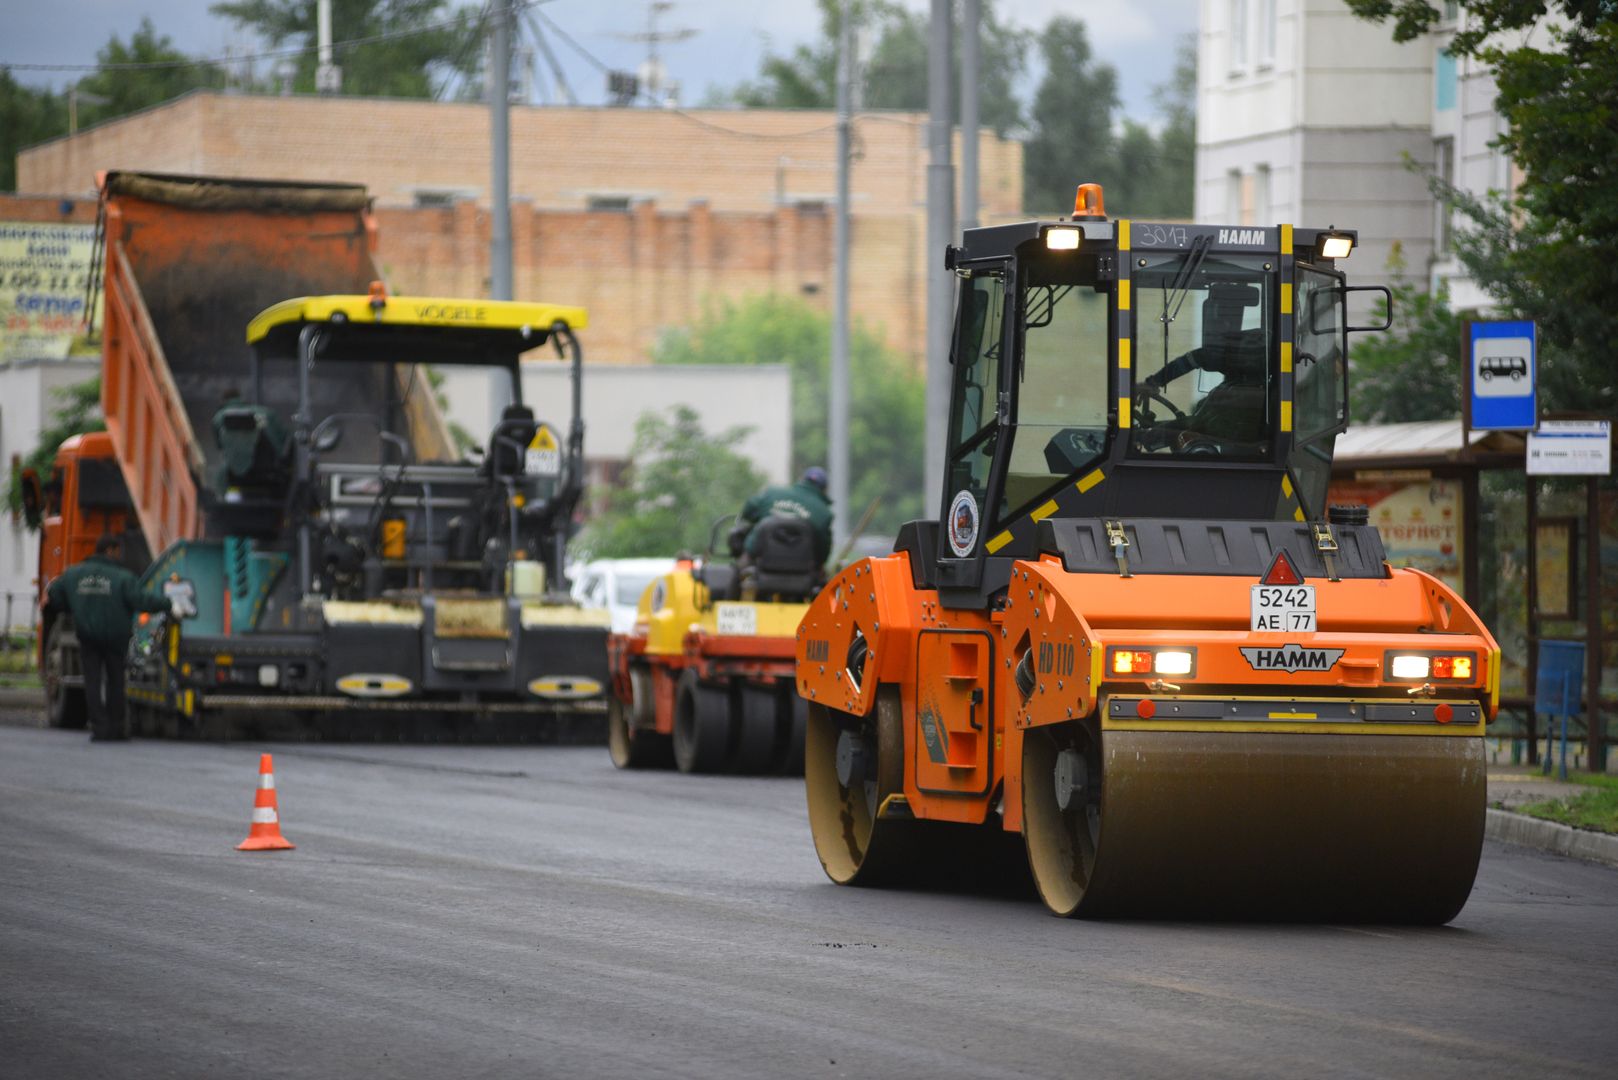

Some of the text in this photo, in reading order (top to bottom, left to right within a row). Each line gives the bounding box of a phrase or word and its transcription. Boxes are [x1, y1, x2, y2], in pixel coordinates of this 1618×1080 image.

[1218, 229, 1265, 245] HAMM
[1259, 588, 1308, 607] 5242
[1257, 615, 1311, 629] AE 77
[1038, 641, 1075, 676] HD 110
[1256, 650, 1327, 668] HAMM
